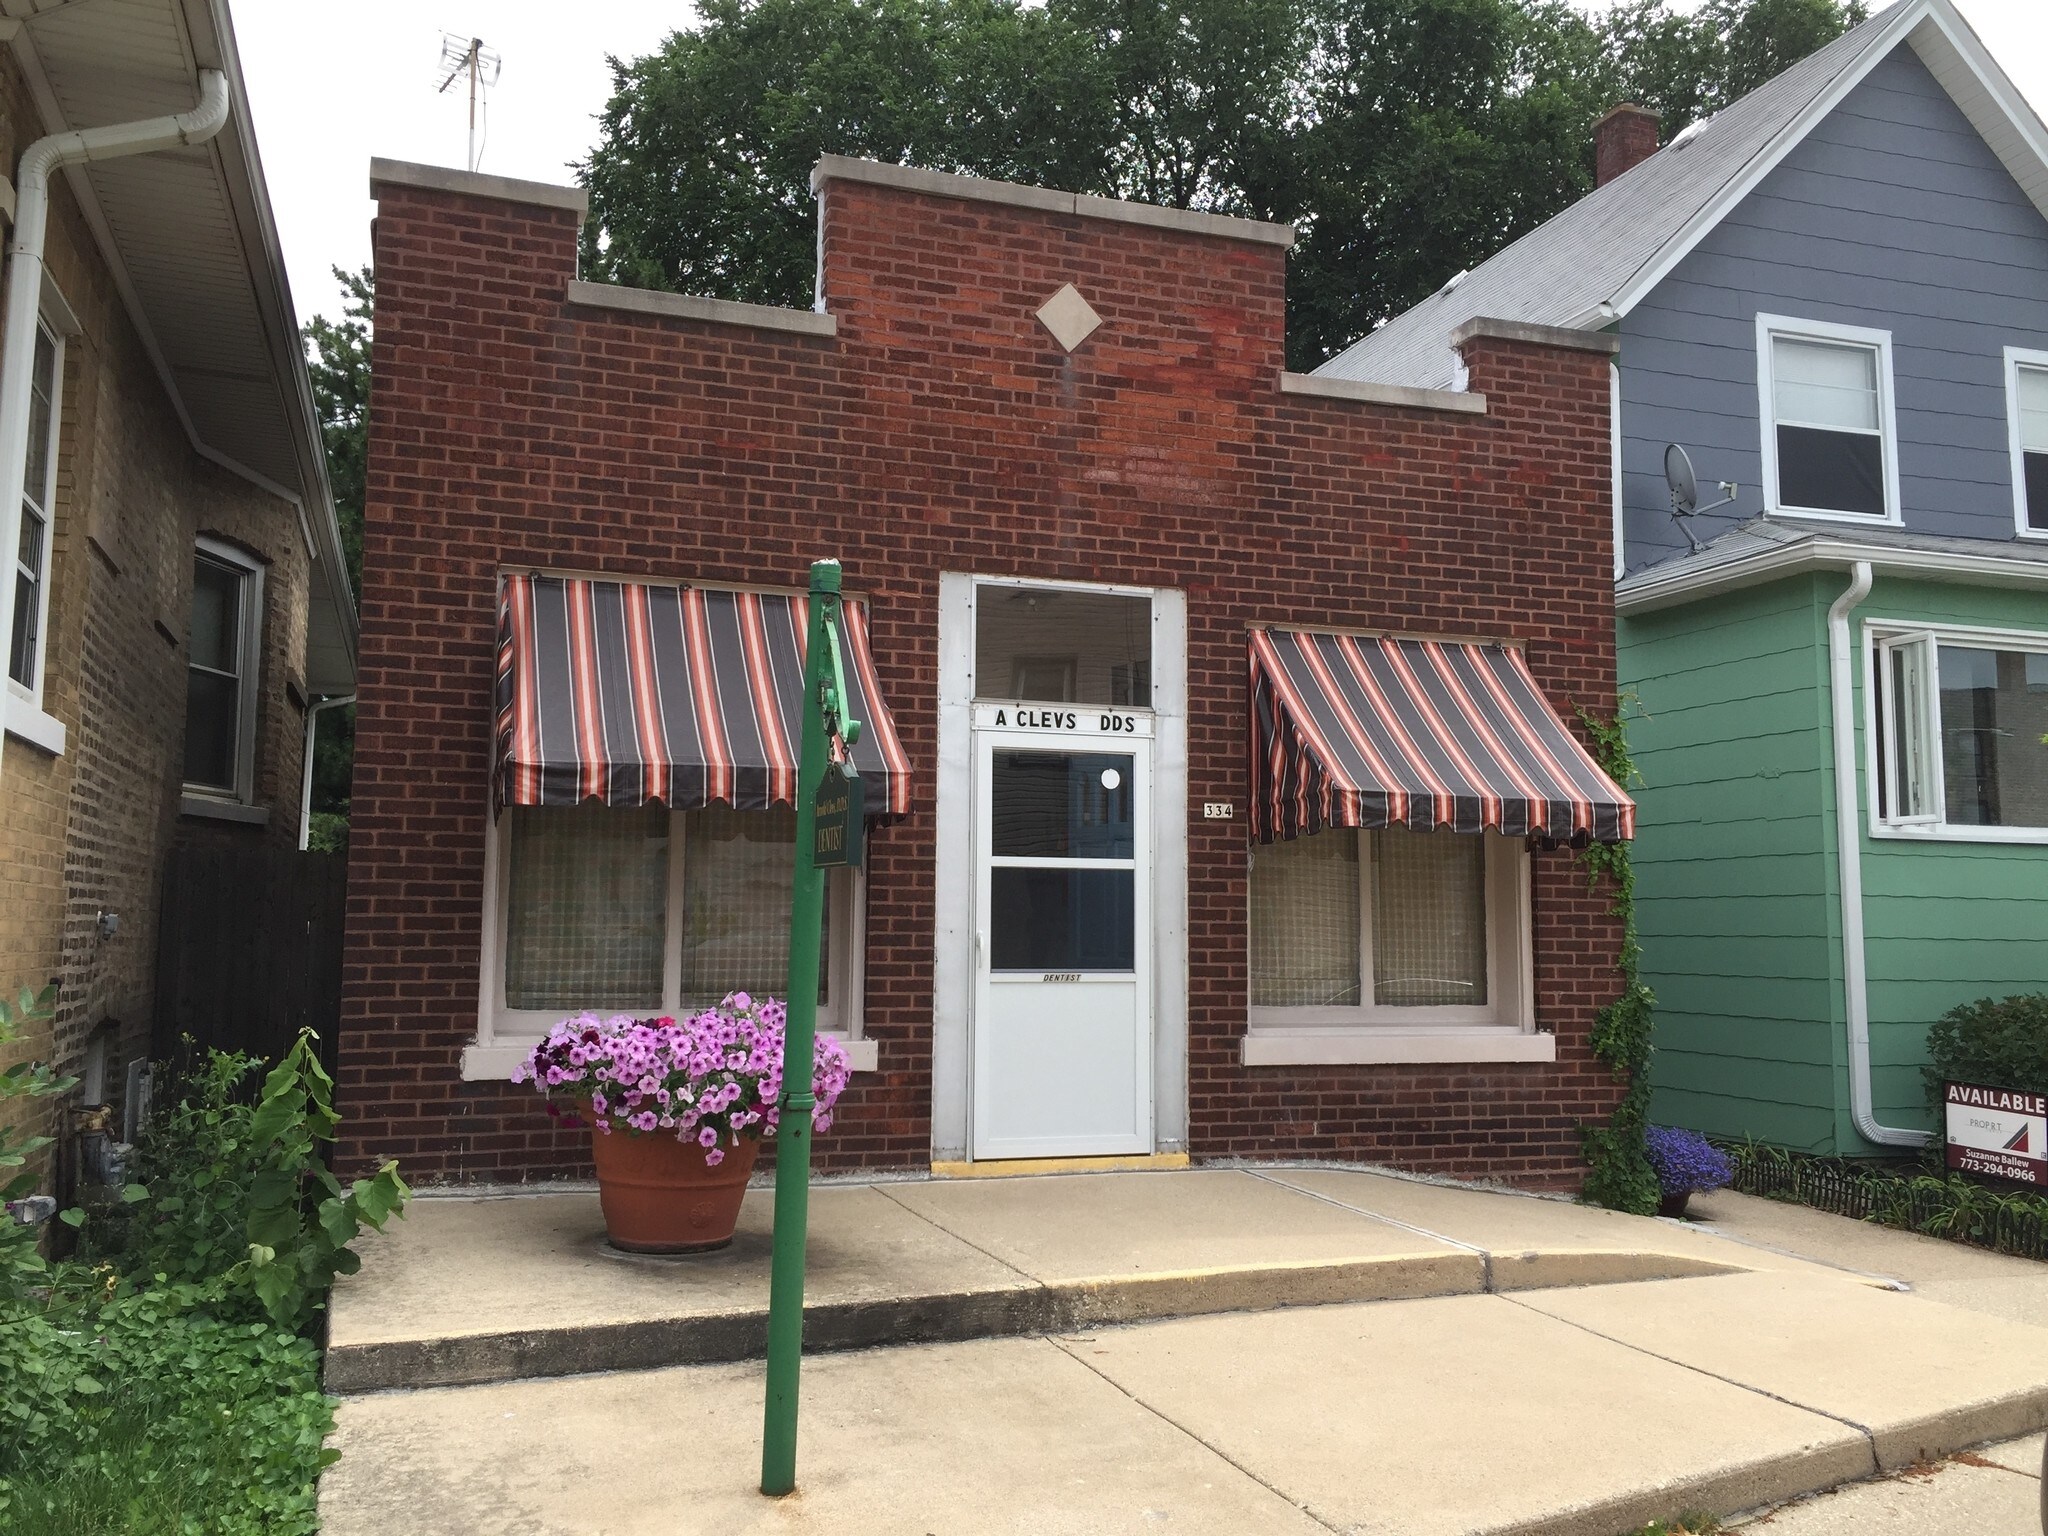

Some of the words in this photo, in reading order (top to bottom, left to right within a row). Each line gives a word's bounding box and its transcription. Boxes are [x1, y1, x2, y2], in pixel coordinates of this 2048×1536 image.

[995, 709, 1007, 726] A
[1016, 710, 1076, 730] CLEVS
[1100, 714, 1135, 733] DDS
[1206, 805, 1232, 817] 334
[818, 825, 844, 853] DENTIST
[1043, 974, 1082, 982] DENTIST
[1948, 1085, 2046, 1115] AVAILABLE
[1959, 1157, 2036, 1182] 773-294-0966
[1965, 1148, 2000, 1163] Suzanne
[2001, 1154, 2030, 1168] Ballew
